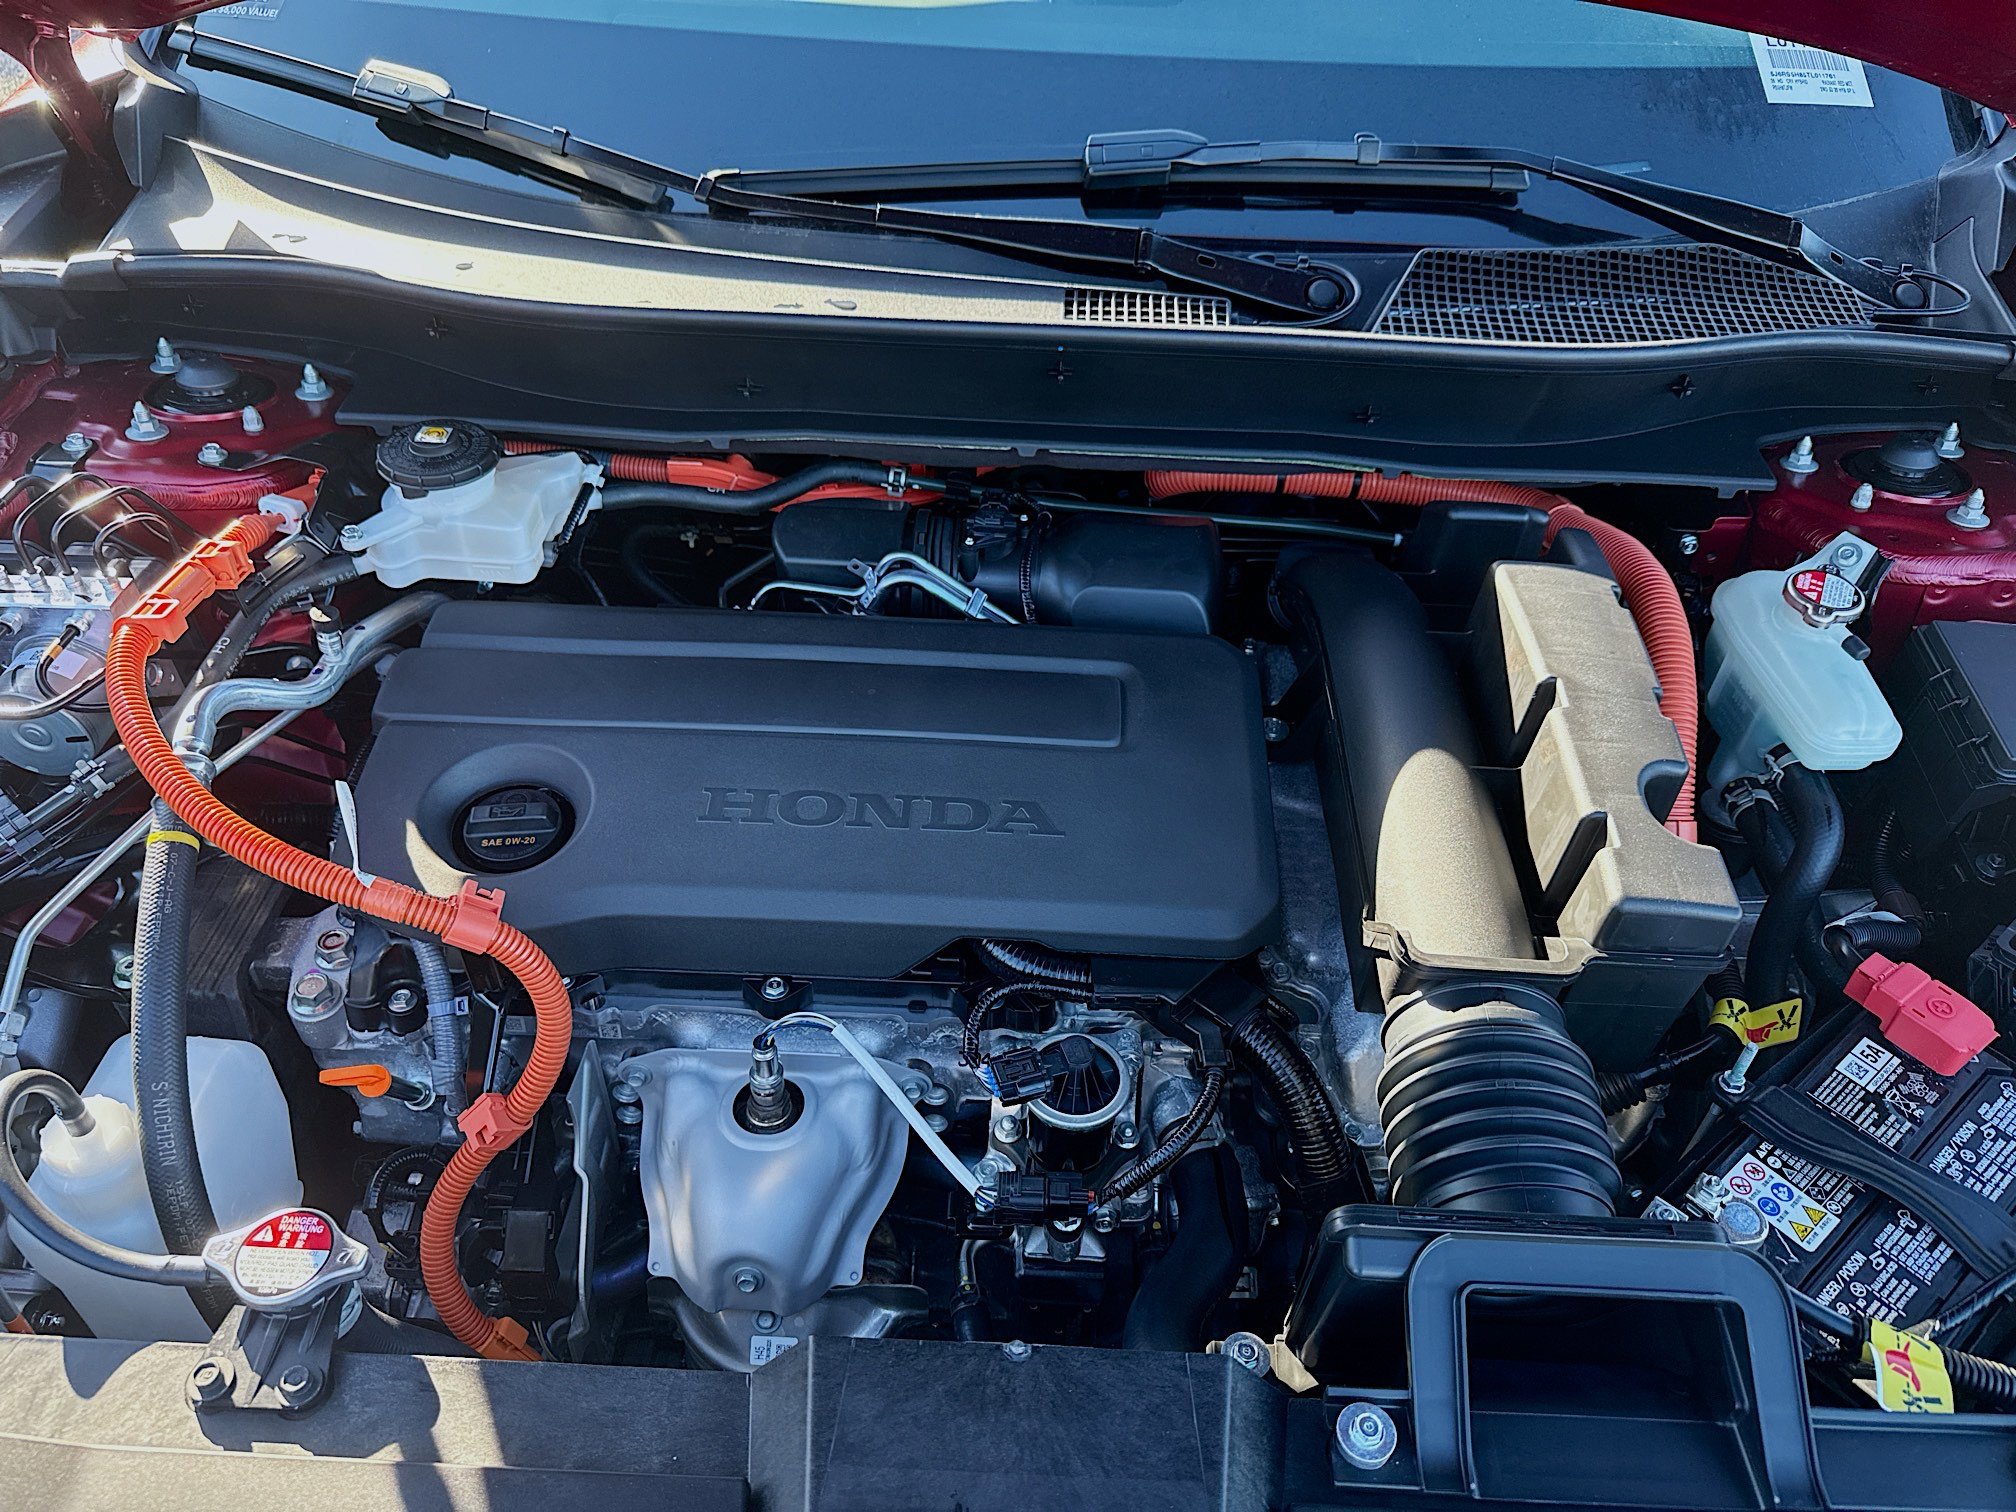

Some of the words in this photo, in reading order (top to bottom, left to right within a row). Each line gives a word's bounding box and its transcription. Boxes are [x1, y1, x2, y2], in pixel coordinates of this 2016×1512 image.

[248, 7, 278, 18] VALUE!
[695, 786, 1067, 838] HONDA
[481, 838, 503, 847] SAE
[505, 836, 536, 846] 0W-20
[1860, 1044, 1886, 1064] 5A
[1928, 1144, 1956, 1174] DANGER
[1952, 1120, 1978, 1147] POISON
[280, 1216, 320, 1225] DANGER
[278, 1224, 324, 1234] WARNUNG
[1816, 1276, 1843, 1306] ANGER
[1840, 1250, 1868, 1281] POISON
[1870, 1270, 1891, 1291] SULFURIC
[1901, 1278, 1910, 1286] OR
[1855, 1297, 1867, 1308] NO
